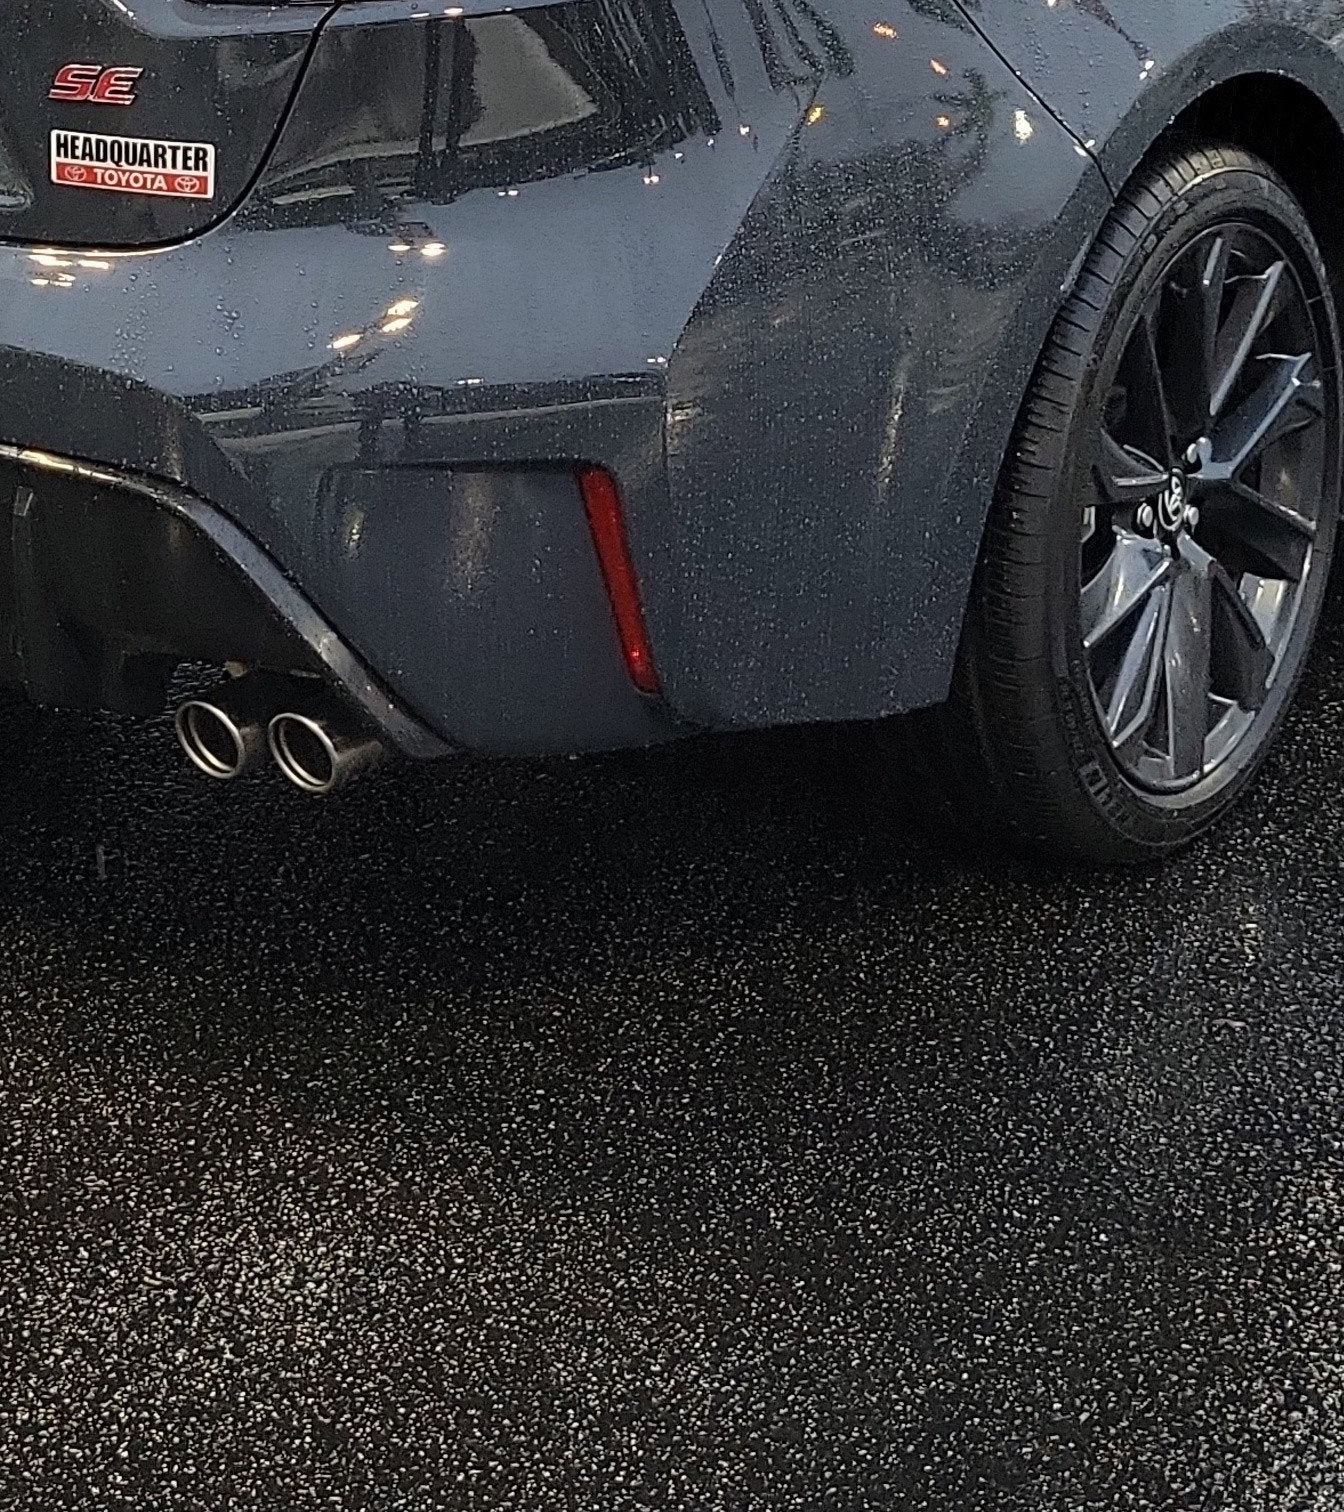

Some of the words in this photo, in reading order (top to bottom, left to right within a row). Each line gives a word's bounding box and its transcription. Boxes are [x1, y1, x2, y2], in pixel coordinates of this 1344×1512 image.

[48, 64, 143, 105] SE
[55, 133, 209, 172] HEADQUARTER
[93, 168, 168, 190] TOYOTA
